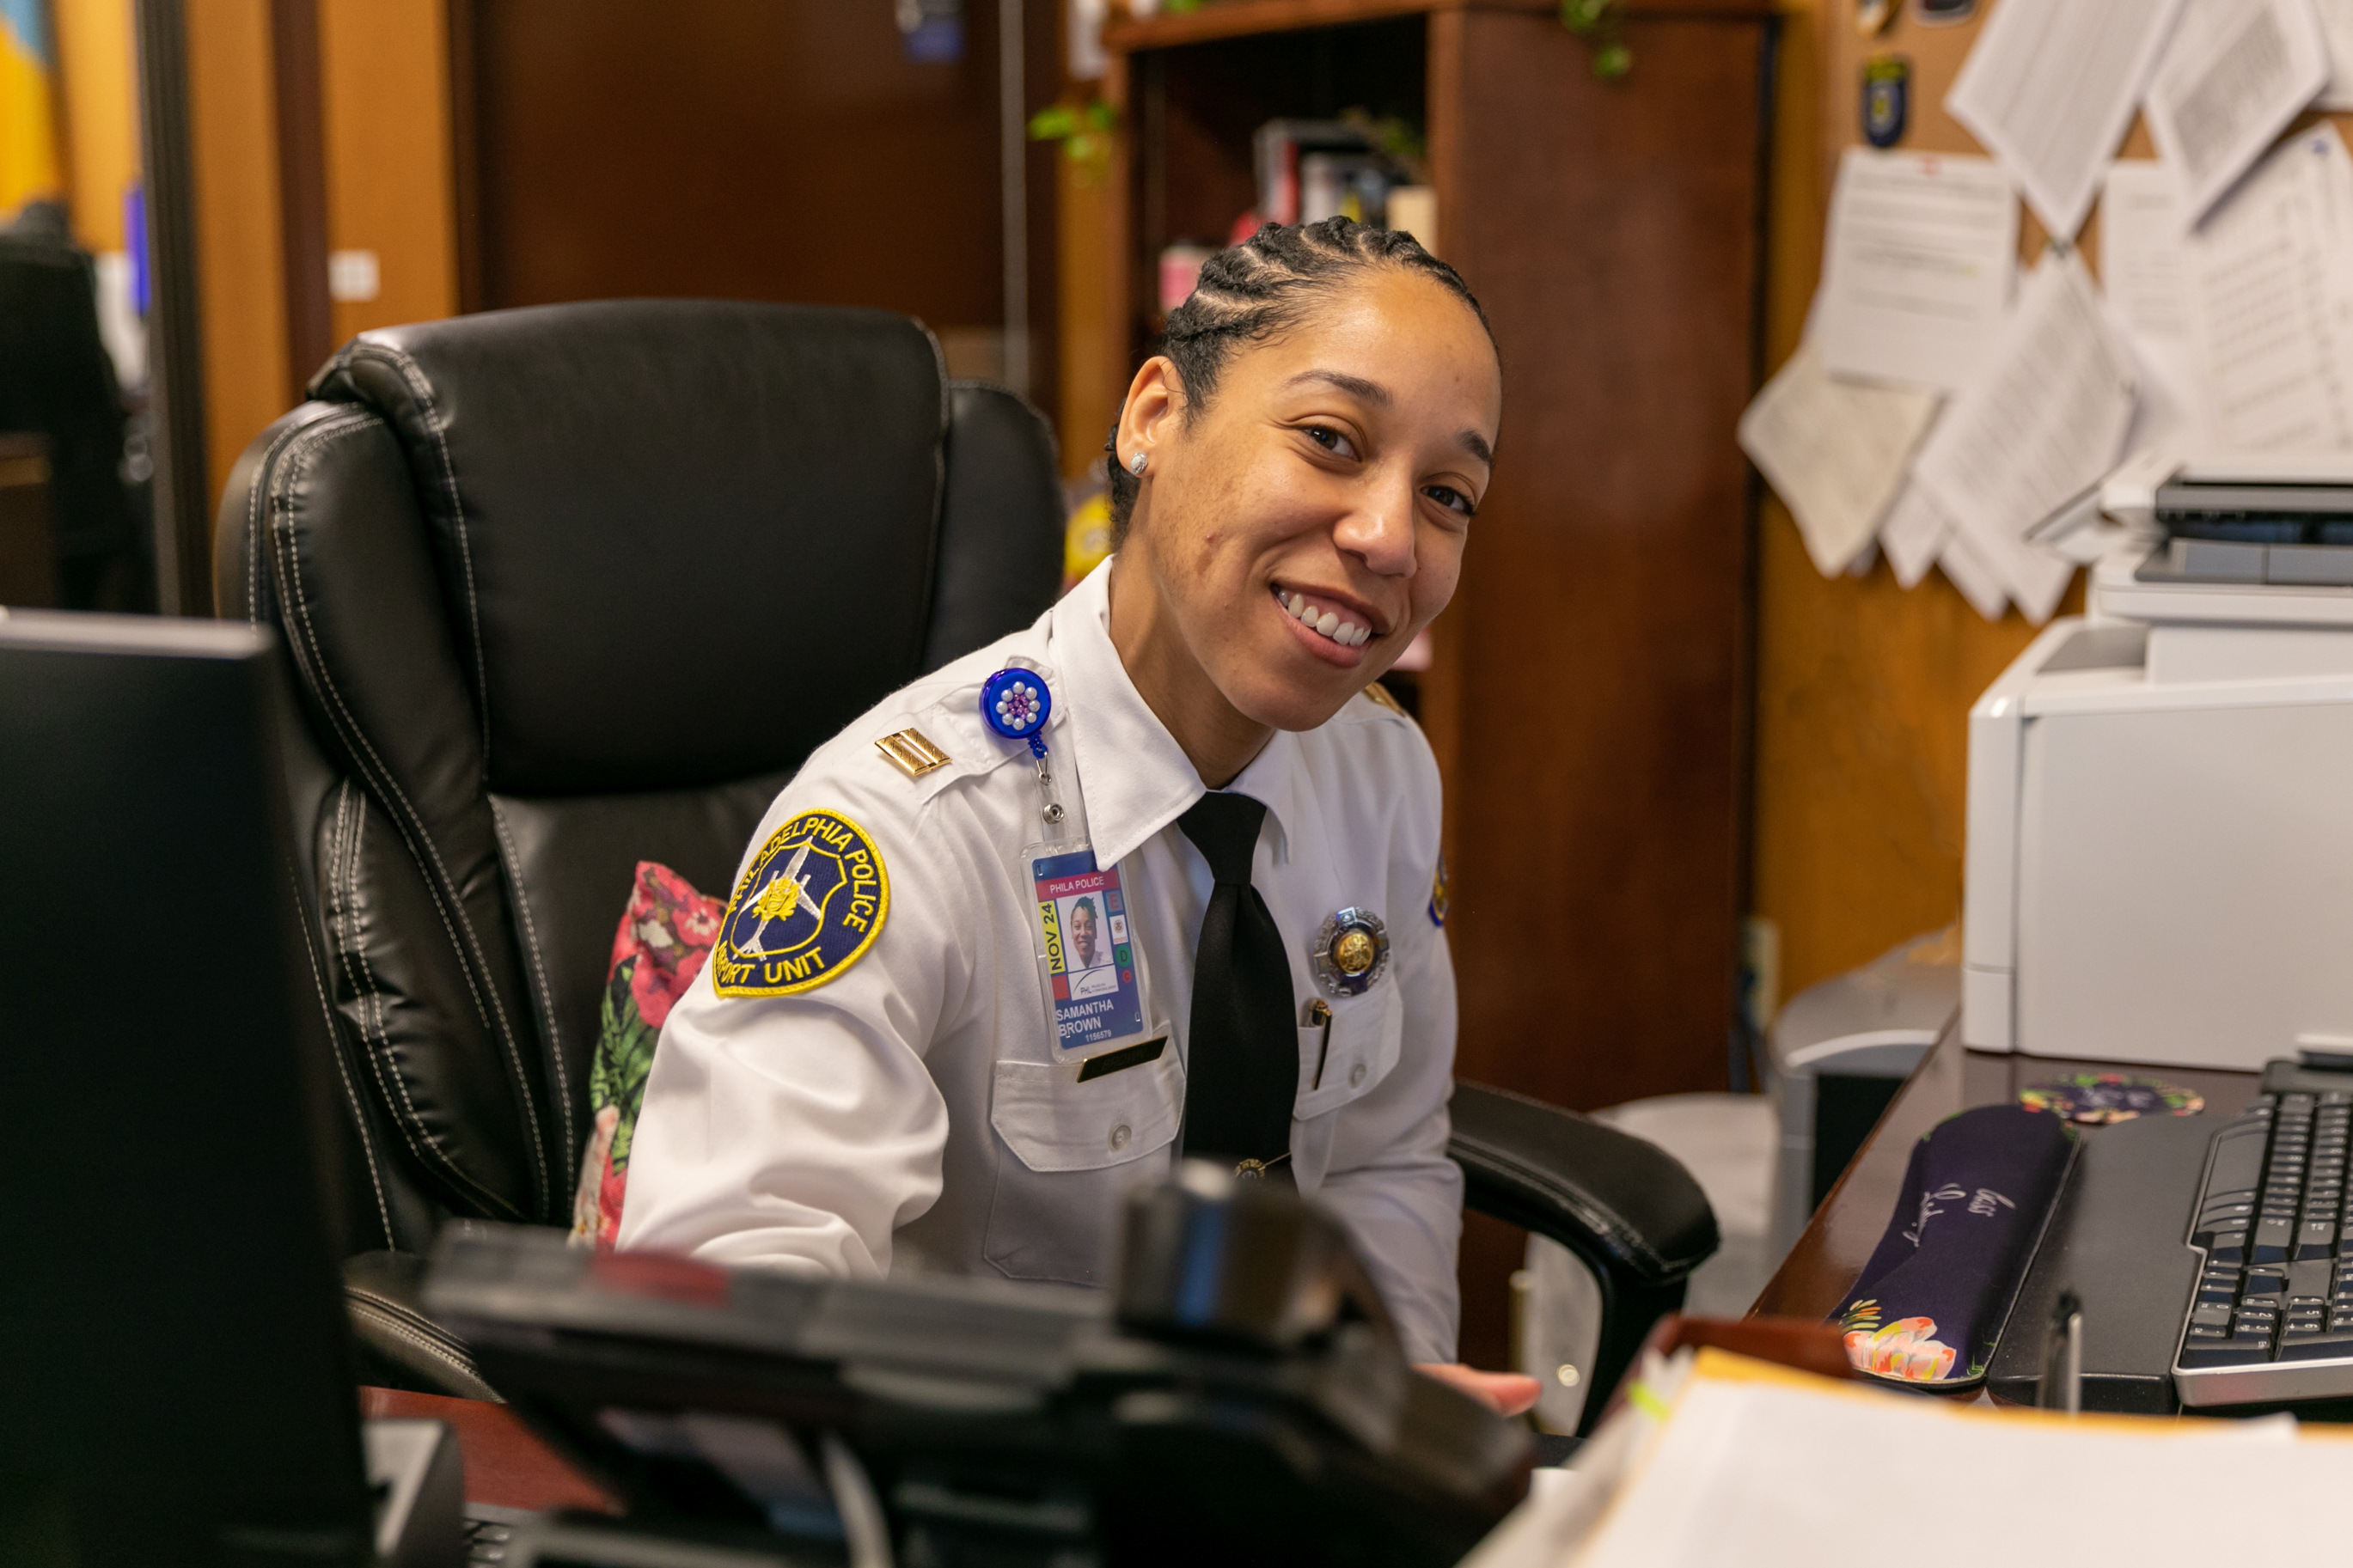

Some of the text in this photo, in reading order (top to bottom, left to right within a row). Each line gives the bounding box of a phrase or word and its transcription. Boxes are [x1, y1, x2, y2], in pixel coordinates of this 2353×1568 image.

[842, 849, 877, 933] POLICE
[1049, 876, 1105, 894] PHILA POLICE
[1109, 894, 1120, 910] E
[1041, 903, 1063, 972] NOV 24
[764, 946, 826, 985] UNIT
[1119, 949, 1128, 962] D
[1055, 998, 1115, 1022] SAMANTHA
[1058, 1016, 1102, 1037] BROWN
